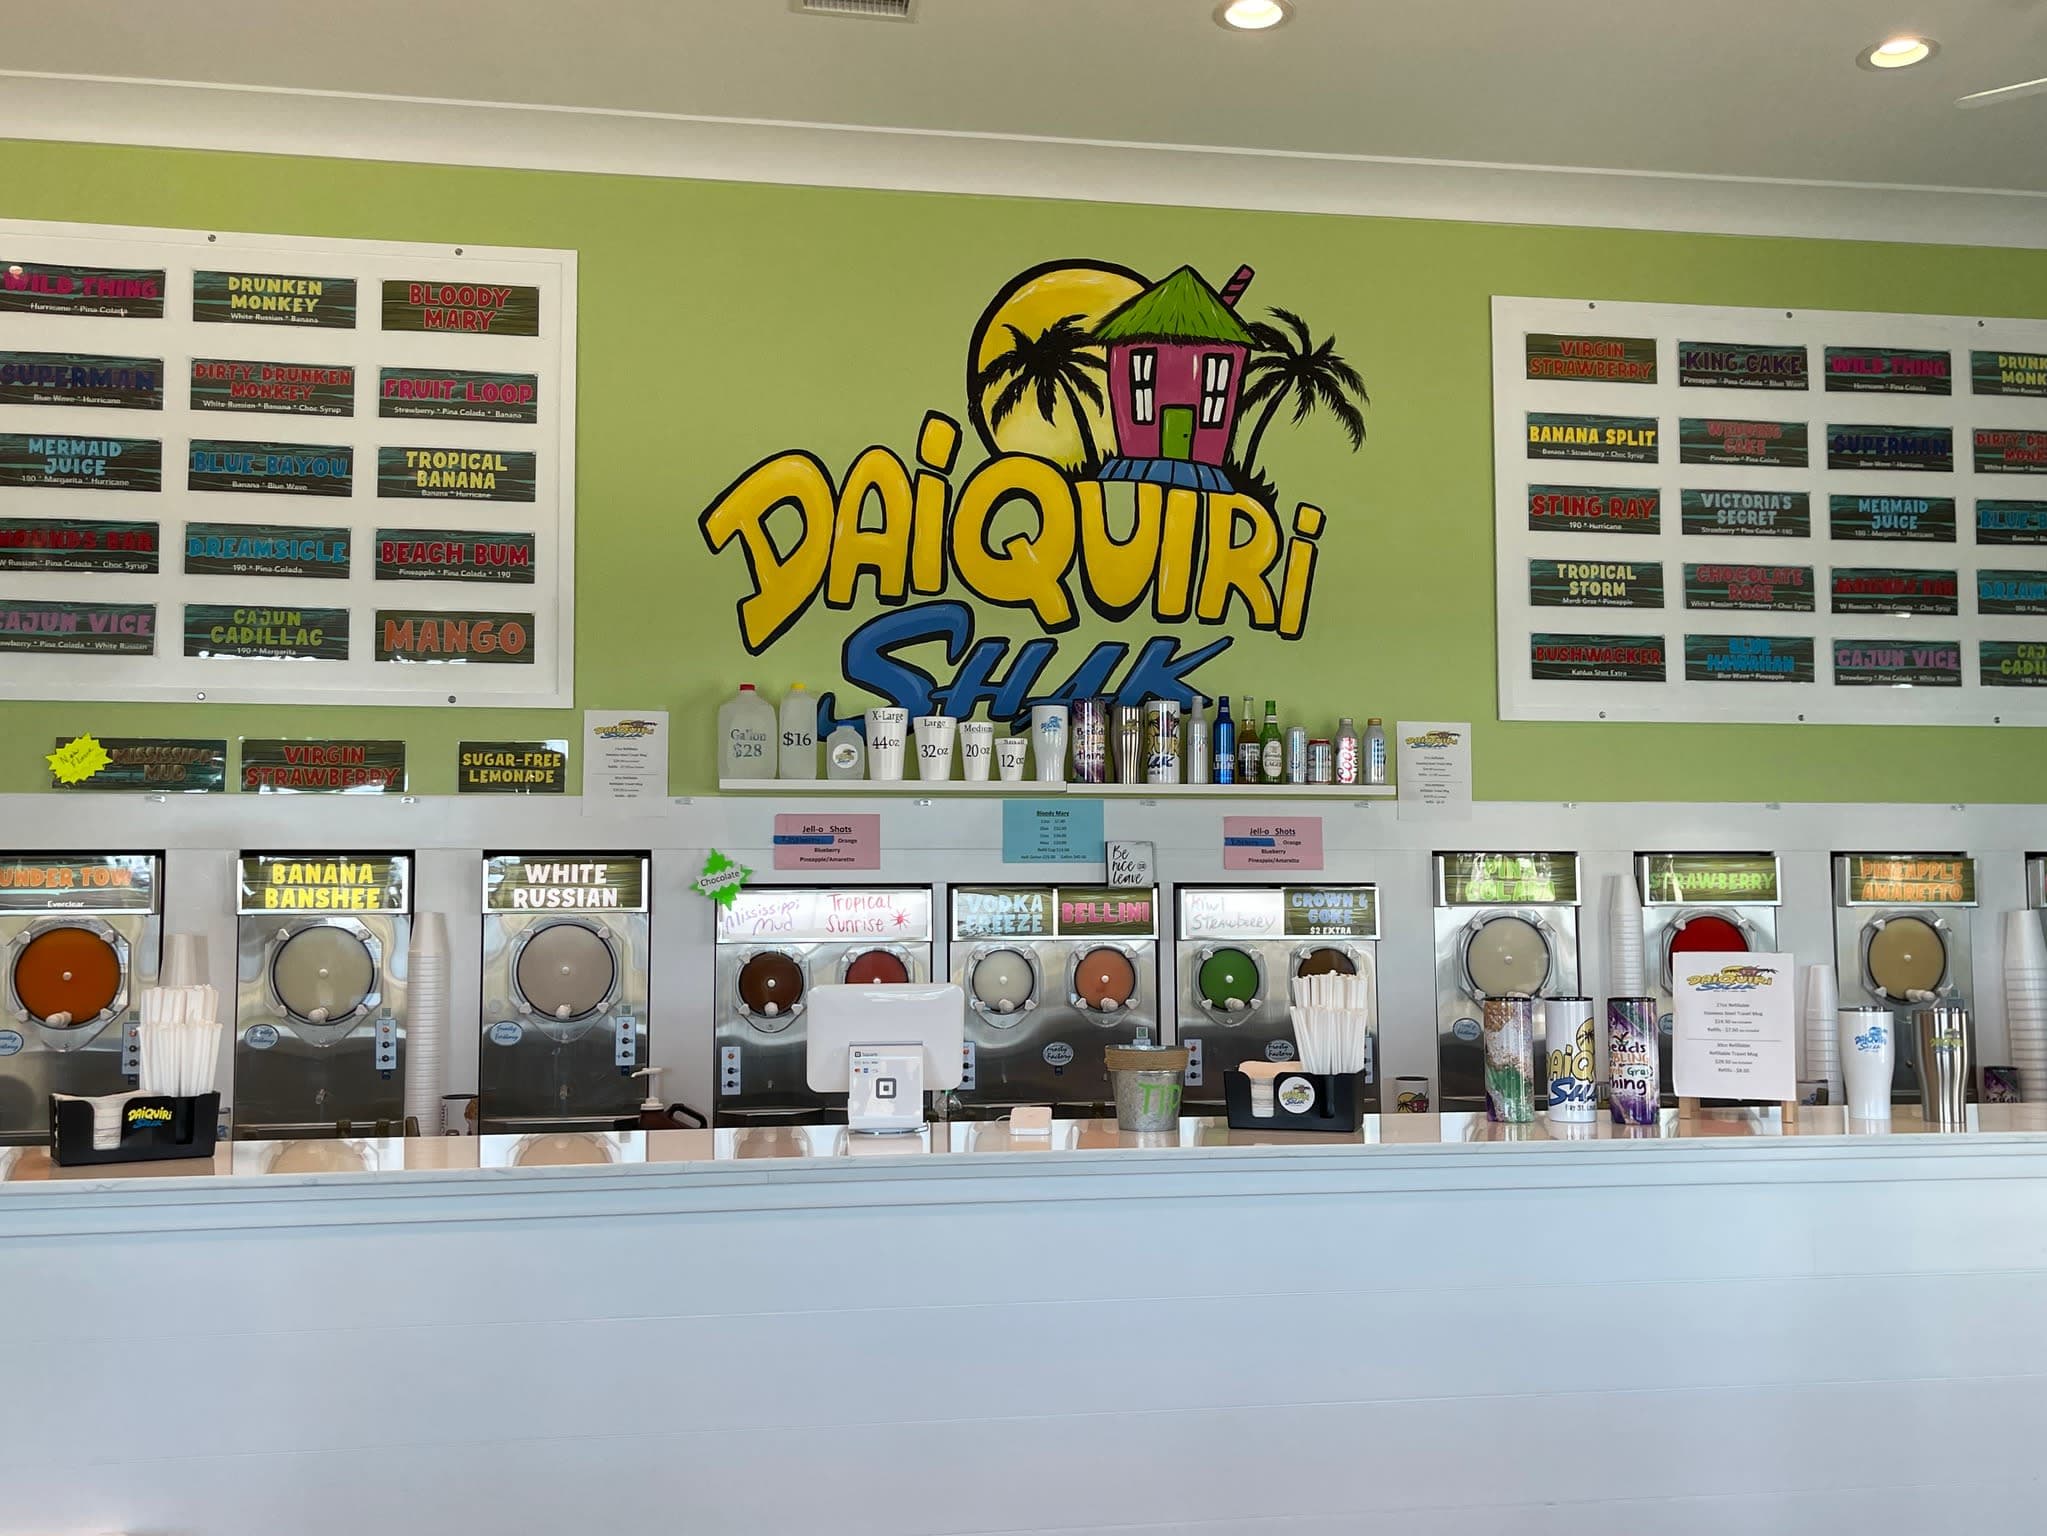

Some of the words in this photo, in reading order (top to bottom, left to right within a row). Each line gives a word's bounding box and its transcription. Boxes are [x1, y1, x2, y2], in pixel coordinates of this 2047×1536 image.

[82, 276, 157, 298] THING
[228, 276, 322, 296] DRUNKEN
[231, 294, 319, 313] MONKEY
[409, 284, 512, 308] BLOODY
[230, 312, 254, 320] White
[291, 316, 318, 324] Banana
[423, 308, 496, 331] MARY
[1560, 340, 1624, 358] VIRGIN
[1529, 357, 1652, 379] STRAWBERRY
[1685, 351, 1738, 371] KING
[1746, 355, 1800, 374] CAKE
[1999, 356, 2047, 369] DRUNK
[1, 364, 155, 390] SUPERMAN
[195, 363, 252, 381] DIRTY
[262, 367, 351, 386] DRUNKEN
[2002, 371, 2047, 385] MONK
[231, 382, 315, 400] MONKEY
[383, 379, 457, 400] FRUIT
[466, 382, 533, 404] LOOP
[203, 400, 226, 408] White
[264, 403, 291, 411] Banana
[299, 404, 317, 412] Choc
[320, 405, 341, 415] Syrup
[394, 406, 435, 416] Strawberry
[460, 409, 485, 417] Colada
[495, 411, 522, 419] Banana
[1530, 425, 1599, 444] BANANA
[1606, 429, 1656, 447] SPLIT
[28, 438, 122, 457] MERMAID
[44, 458, 106, 476] JUICE
[193, 451, 254, 474] BLUE
[266, 453, 347, 478] BAYOU
[406, 451, 508, 471] TROPICAL
[44, 476, 83, 486] Margarita
[91, 477, 130, 486] Hurricane
[232, 481, 260, 489] Banana
[416, 471, 496, 489] BANANA
[422, 489, 448, 497] Banana
[456, 490, 492, 498] Hurricane
[1700, 492, 1792, 509] VICTORIA'S
[1532, 494, 1602, 517] STING
[1610, 496, 1656, 520] RAY
[1859, 499, 1928, 513] MERMAID
[1569, 521, 1582, 529] 190
[1717, 510, 1777, 526] SECRET
[1872, 515, 1918, 529] JUICE
[105, 531, 153, 551] BAR
[188, 535, 346, 564] DREAMSICLE
[381, 541, 464, 566] BEACH
[474, 543, 528, 567] BUM
[102, 561, 123, 569] Choc
[125, 562, 148, 571] Syrup
[1557, 563, 1636, 581] TROPICAL
[1696, 567, 1803, 585] CHOCOLATE
[1570, 581, 1626, 597] STORM
[1980, 581, 2047, 599] DREAM
[89, 613, 149, 636] VICE
[233, 609, 301, 626] CAJUN
[211, 626, 323, 646] CADILLAC
[383, 620, 526, 654] MANGO
[1536, 646, 1661, 665] BUSHWACKER
[1837, 649, 1905, 669] CAJUN
[1914, 650, 1958, 669] VICE
[2017, 645, 2047, 659] CAJ
[816, 600, 1234, 741] SHAK
[2000, 660, 2047, 676] CADIL
[872, 710, 904, 722] X-Large
[924, 719, 946, 729] Large
[730, 729, 766, 741] Gallon
[964, 724, 993, 733] Medium
[783, 731, 812, 746] $16
[283, 746, 365, 765] VIRGIN
[733, 743, 762, 758] $28
[462, 753, 561, 767] SUGAR-FREE
[144, 764, 186, 781] MUD
[245, 767, 399, 787] STRAWBERRY
[469, 769, 554, 783] LEMONADE
[802, 825, 824, 833] Jell-o
[830, 825, 852, 833] Shots
[1250, 827, 1270, 836] Jell-o
[1275, 828, 1296, 836] Shots
[1112, 845, 1129, 860] Be
[1261, 848, 1286, 856] Blueberry
[272, 863, 373, 884] BANANA
[524, 863, 607, 884] WHITE
[1112, 859, 1135, 872] nice
[1860, 861, 1963, 880] PINEAPPLE
[0, 867, 74, 888] UNDER
[80, 867, 133, 887] TOW
[700, 869, 740, 887] Chocolate
[1112, 870, 1143, 885] leave
[1650, 872, 1775, 889] STRAWBERRY
[264, 887, 380, 909] BANSHEE
[513, 887, 618, 908] RUSSIAN
[1292, 893, 1353, 908] CROWN
[1862, 883, 1964, 901] AMARETTO
[47, 900, 85, 908] Everclear
[826, 893, 892, 912] Tropical
[966, 895, 1043, 913] VODKA
[725, 899, 800, 934] Mississippi
[1061, 902, 1149, 924] BELLINI
[1308, 909, 1352, 924] COKE
[752, 917, 793, 936] Mud
[826, 914, 884, 934] Sunrise
[965, 913, 1043, 934] FREEZE
[1310, 926, 1320, 935] $2
[1323, 926, 1352, 935] EXTRA
[1609, 1042, 1646, 1053] eads
